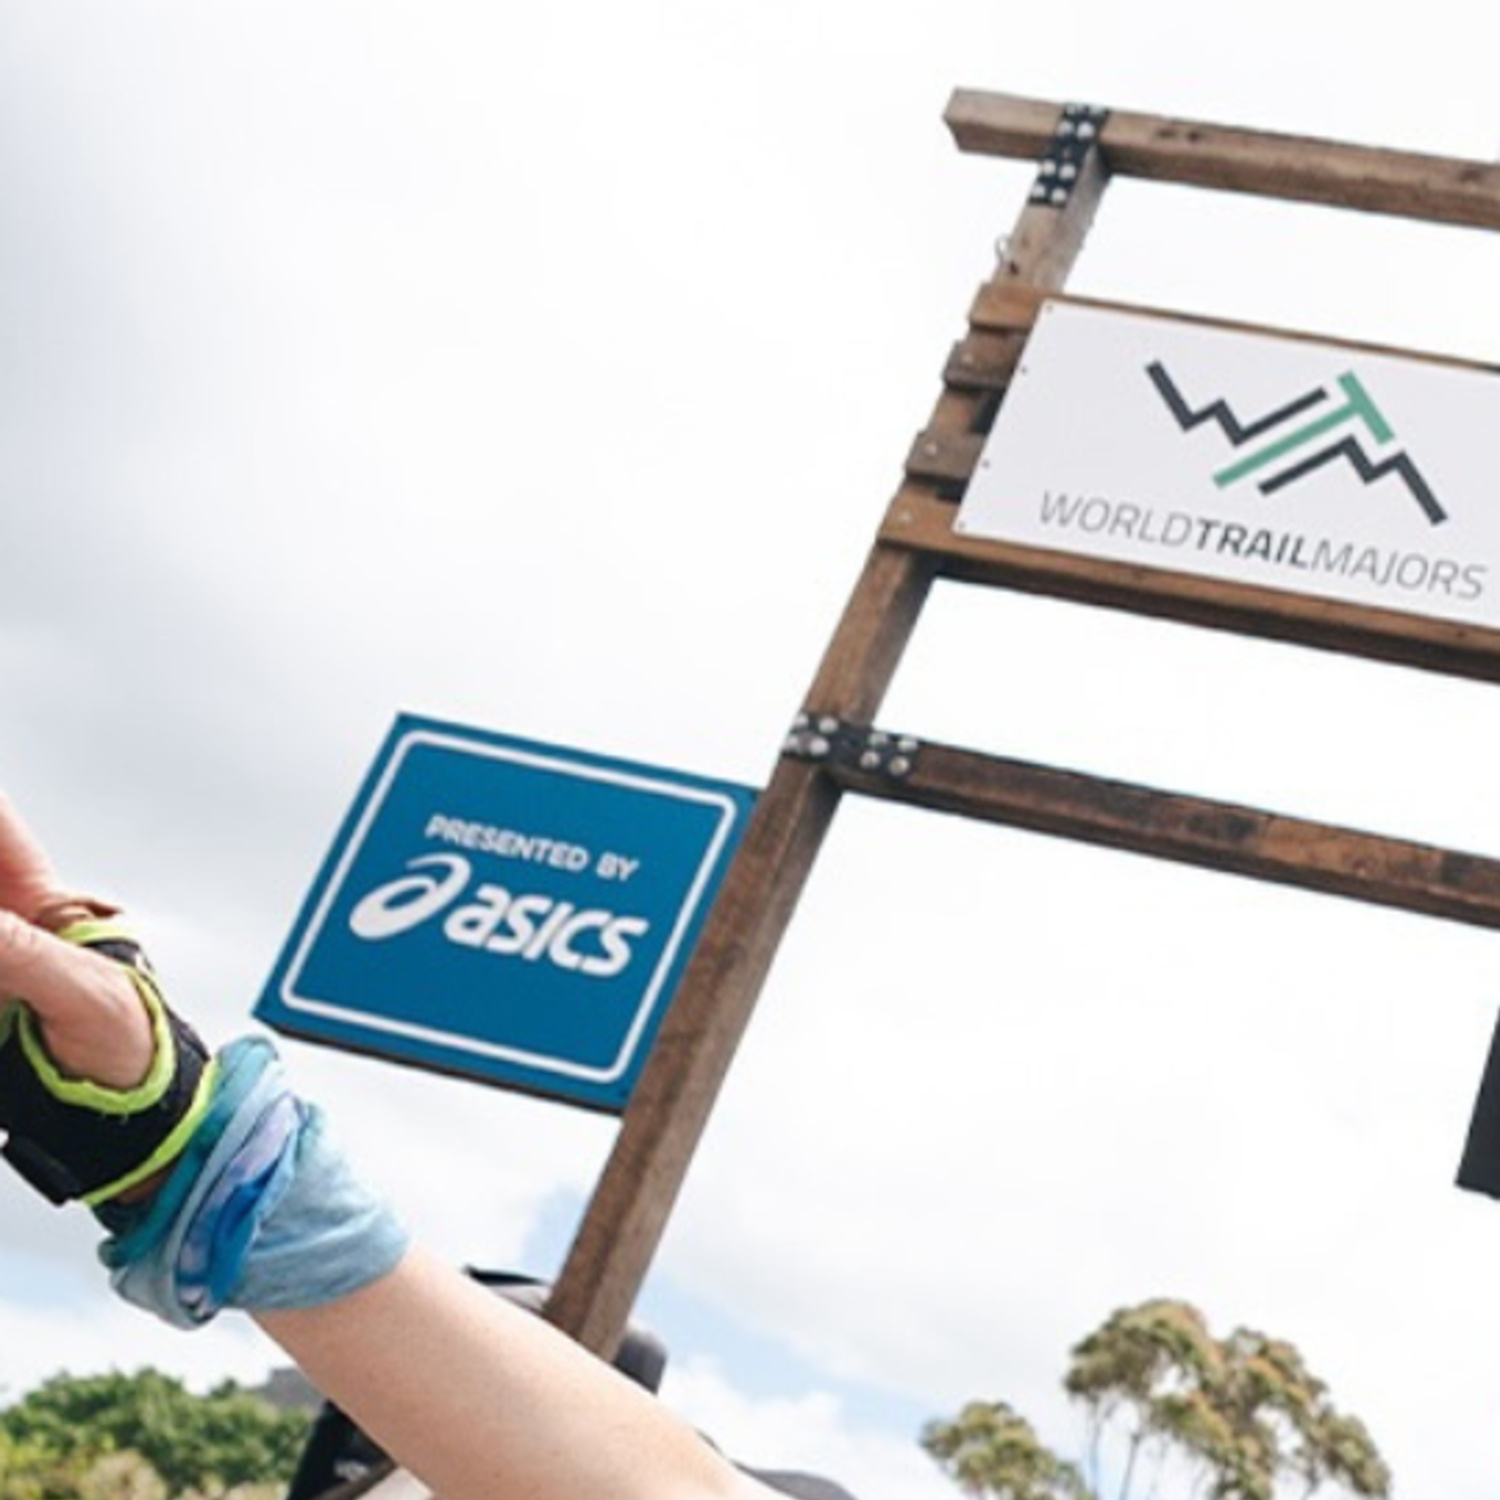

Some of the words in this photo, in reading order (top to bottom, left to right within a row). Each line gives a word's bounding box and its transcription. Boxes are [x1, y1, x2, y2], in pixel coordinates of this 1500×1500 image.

[1038, 490, 1488, 600] WORLDTRAILMAJORS
[425, 813, 590, 873] PRESENTED
[595, 852, 640, 882] BY
